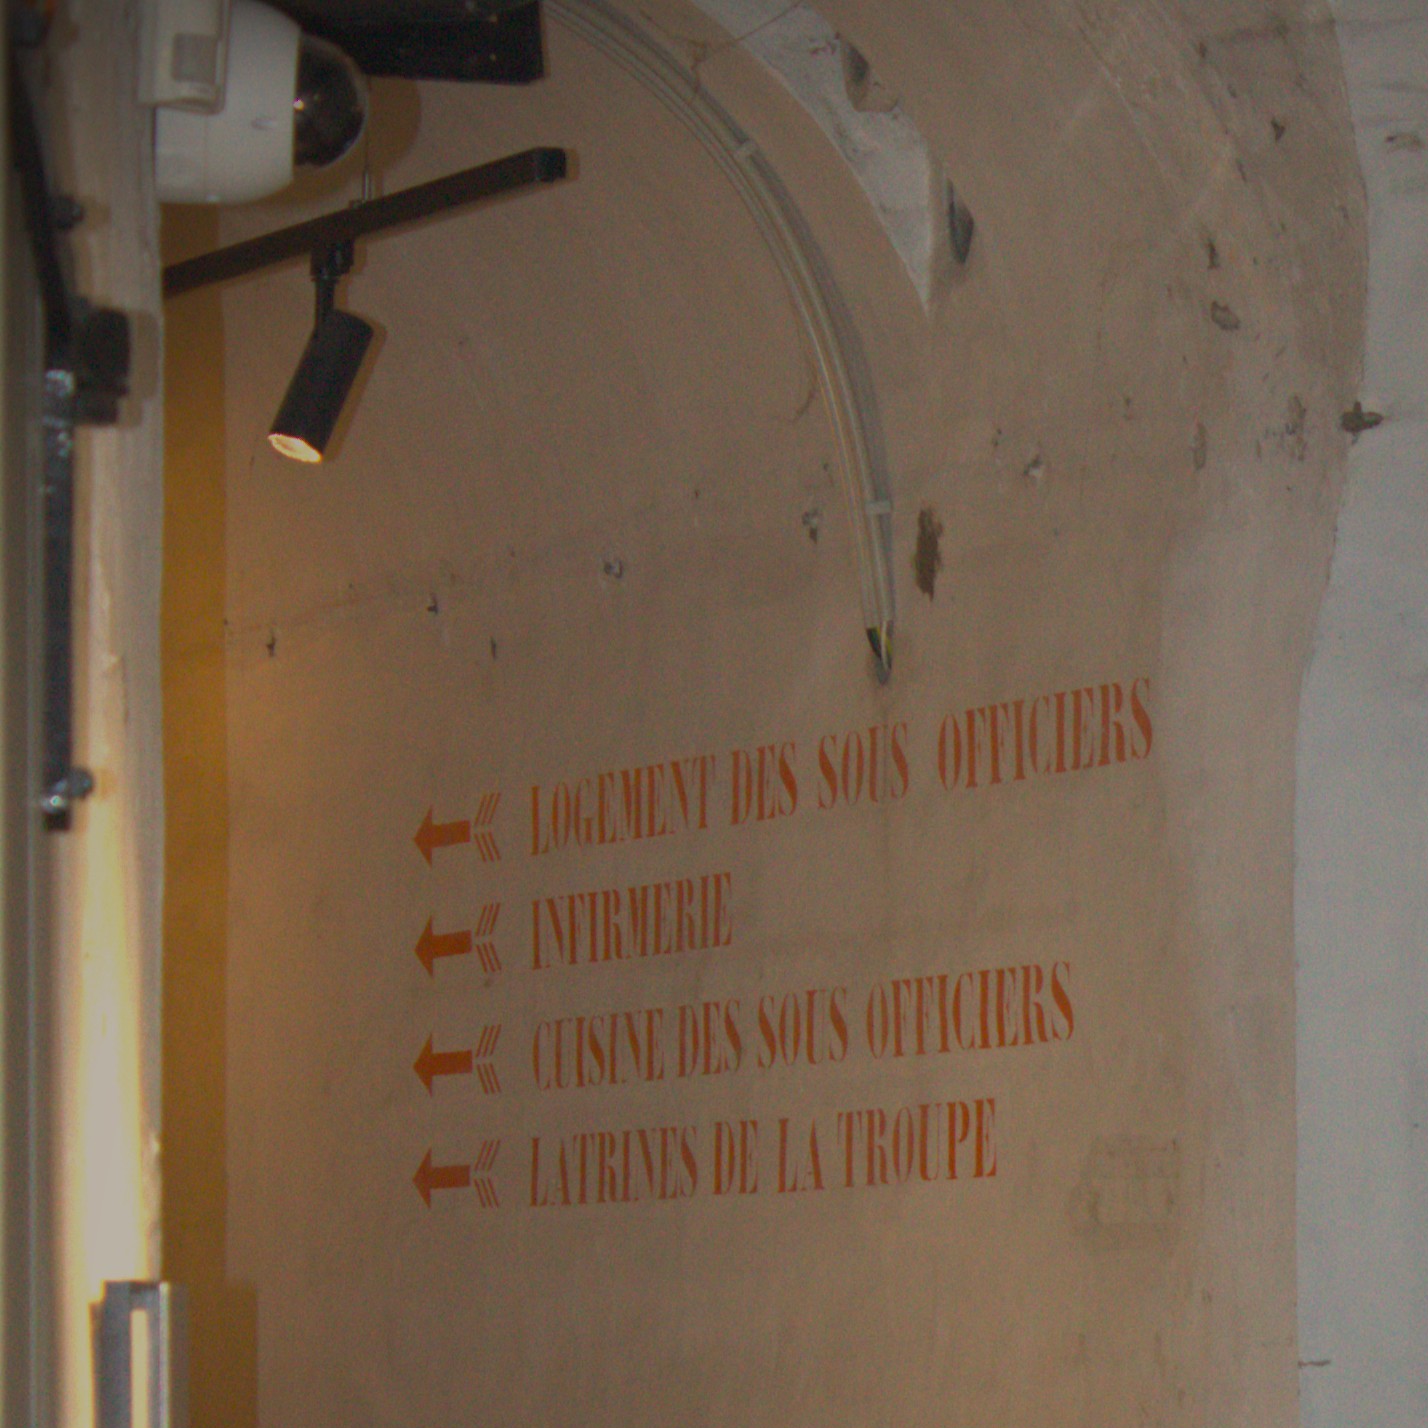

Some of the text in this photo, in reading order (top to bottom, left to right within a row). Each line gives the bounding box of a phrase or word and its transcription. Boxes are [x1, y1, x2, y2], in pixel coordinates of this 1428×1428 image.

[530, 677, 1153, 857] LOGEMENT DES SOUS OFFICIERS
[531, 870, 732, 970] INFIRMERIE
[532, 960, 1075, 1093] CUISINE DES SOUS OFFICIERS
[529, 1097, 998, 1208] LATRINES DE LA TROUPE
